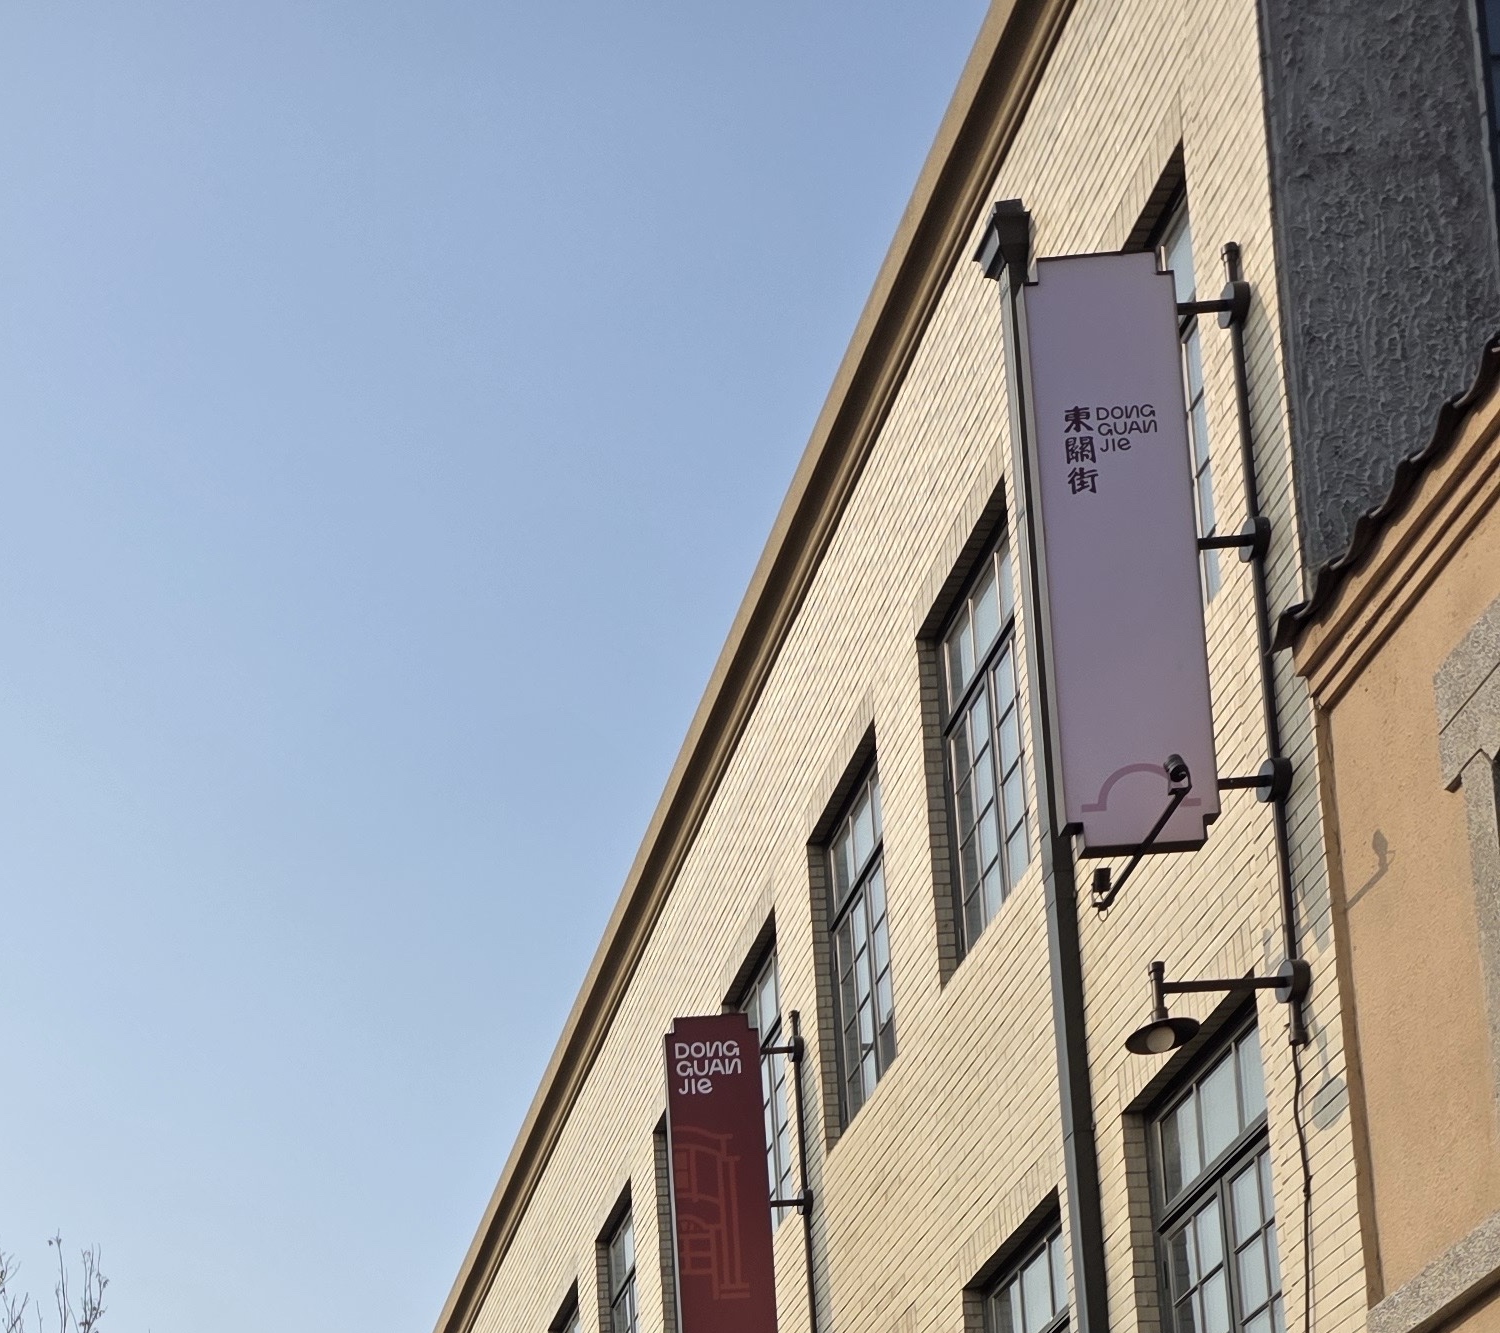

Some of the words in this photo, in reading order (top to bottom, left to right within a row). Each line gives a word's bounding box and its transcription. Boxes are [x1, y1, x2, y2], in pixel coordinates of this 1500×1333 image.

[1096, 403, 1156, 421] DONG
[1097, 419, 1158, 437] GUAN
[1064, 405, 1099, 495] 東關街
[674, 1040, 740, 1059] DONG
[676, 1058, 742, 1077] GUAN
